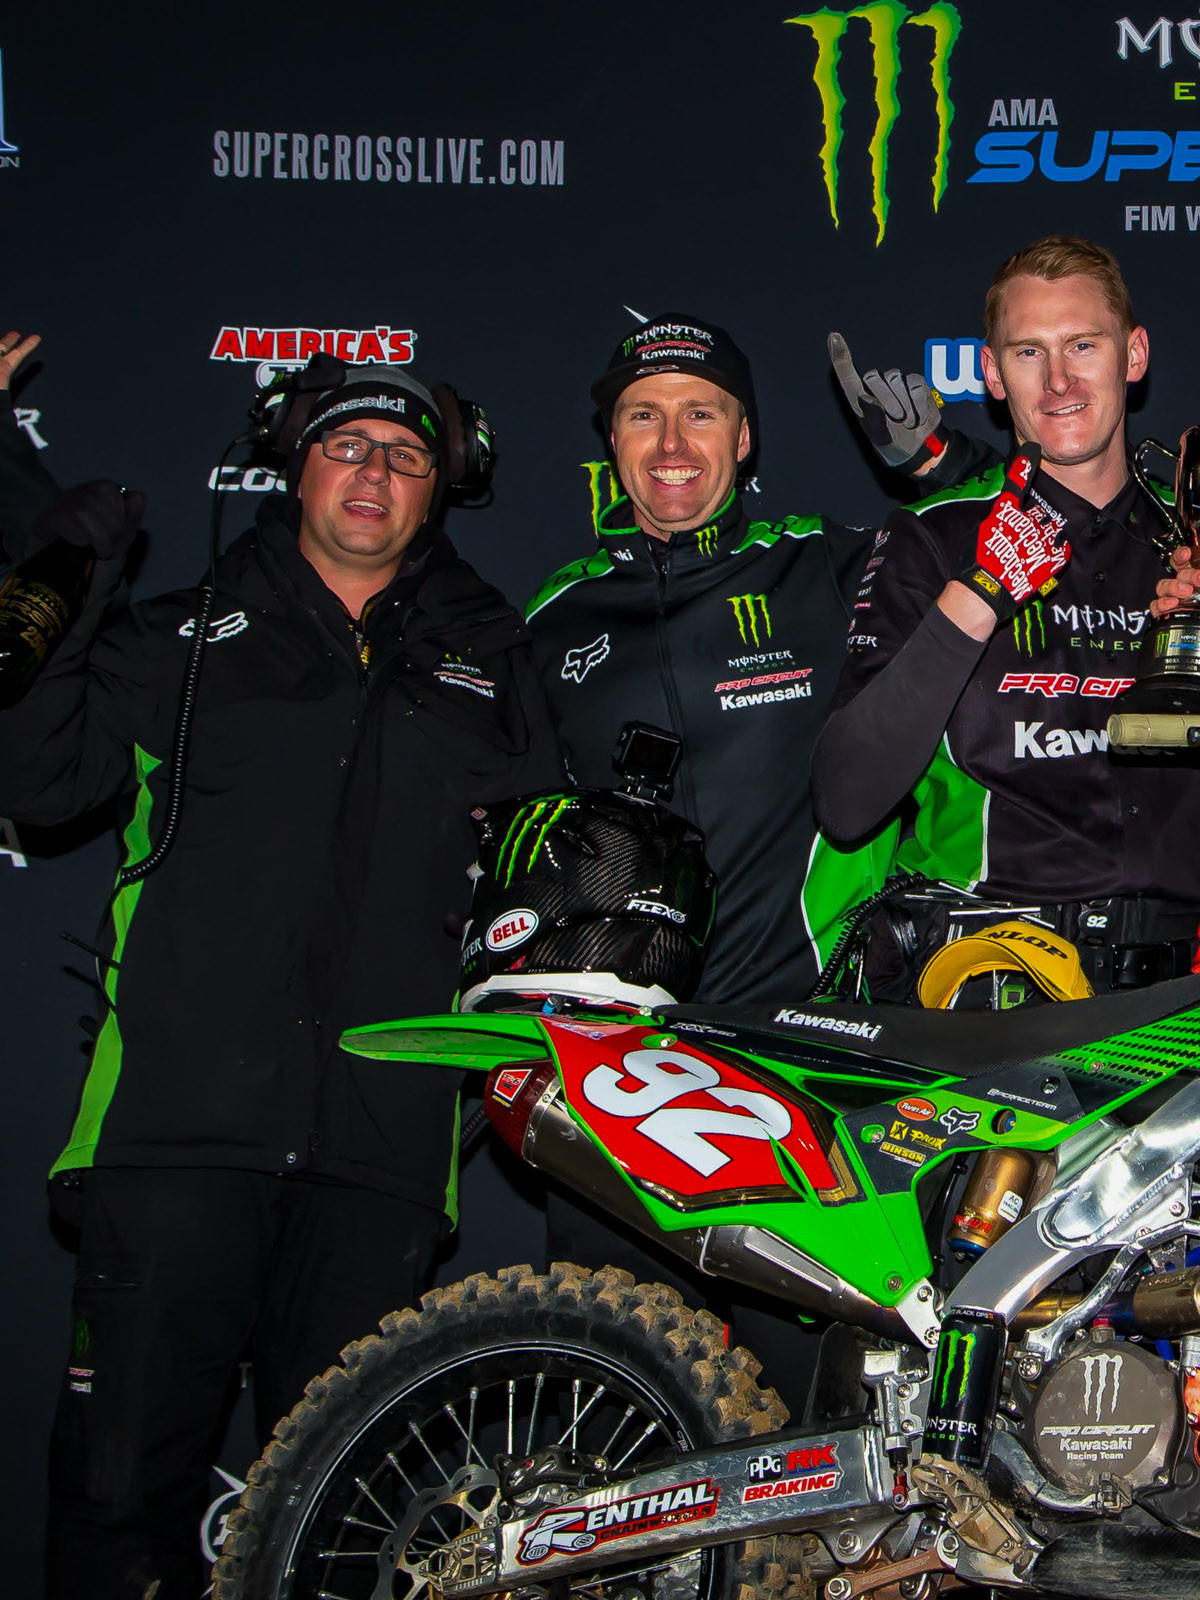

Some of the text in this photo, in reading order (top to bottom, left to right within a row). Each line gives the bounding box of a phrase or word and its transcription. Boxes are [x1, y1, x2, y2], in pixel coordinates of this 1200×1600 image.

[988, 99, 1059, 126] AMA
[213, 130, 564, 186] SUPERCROSSLIVE.COM
[1125, 205, 1176, 232] FIM
[211, 326, 414, 365] AMERICA'S
[636, 323, 714, 346] MONSTER
[641, 349, 705, 361] Kawasaki
[728, 650, 793, 668] MONSTER
[714, 668, 813, 692] PRO CIRCUIT
[998, 672, 1080, 698] PRO
[720, 682, 812, 711] Kawasaki
[492, 917, 529, 945] BELL
[1086, 915, 1108, 928] 92
[775, 1009, 884, 1040] Kawasaki
[583, 1049, 792, 1178] 92
[1040, 1424, 1156, 1436] PRO CIRCUIT
[1060, 1437, 1132, 1452] Kawasaki
[1067, 1452, 1124, 1462] Racing Team
[749, 1455, 781, 1481] PPG
[787, 1445, 835, 1471] RK
[743, 1474, 836, 1502] BRAKING
